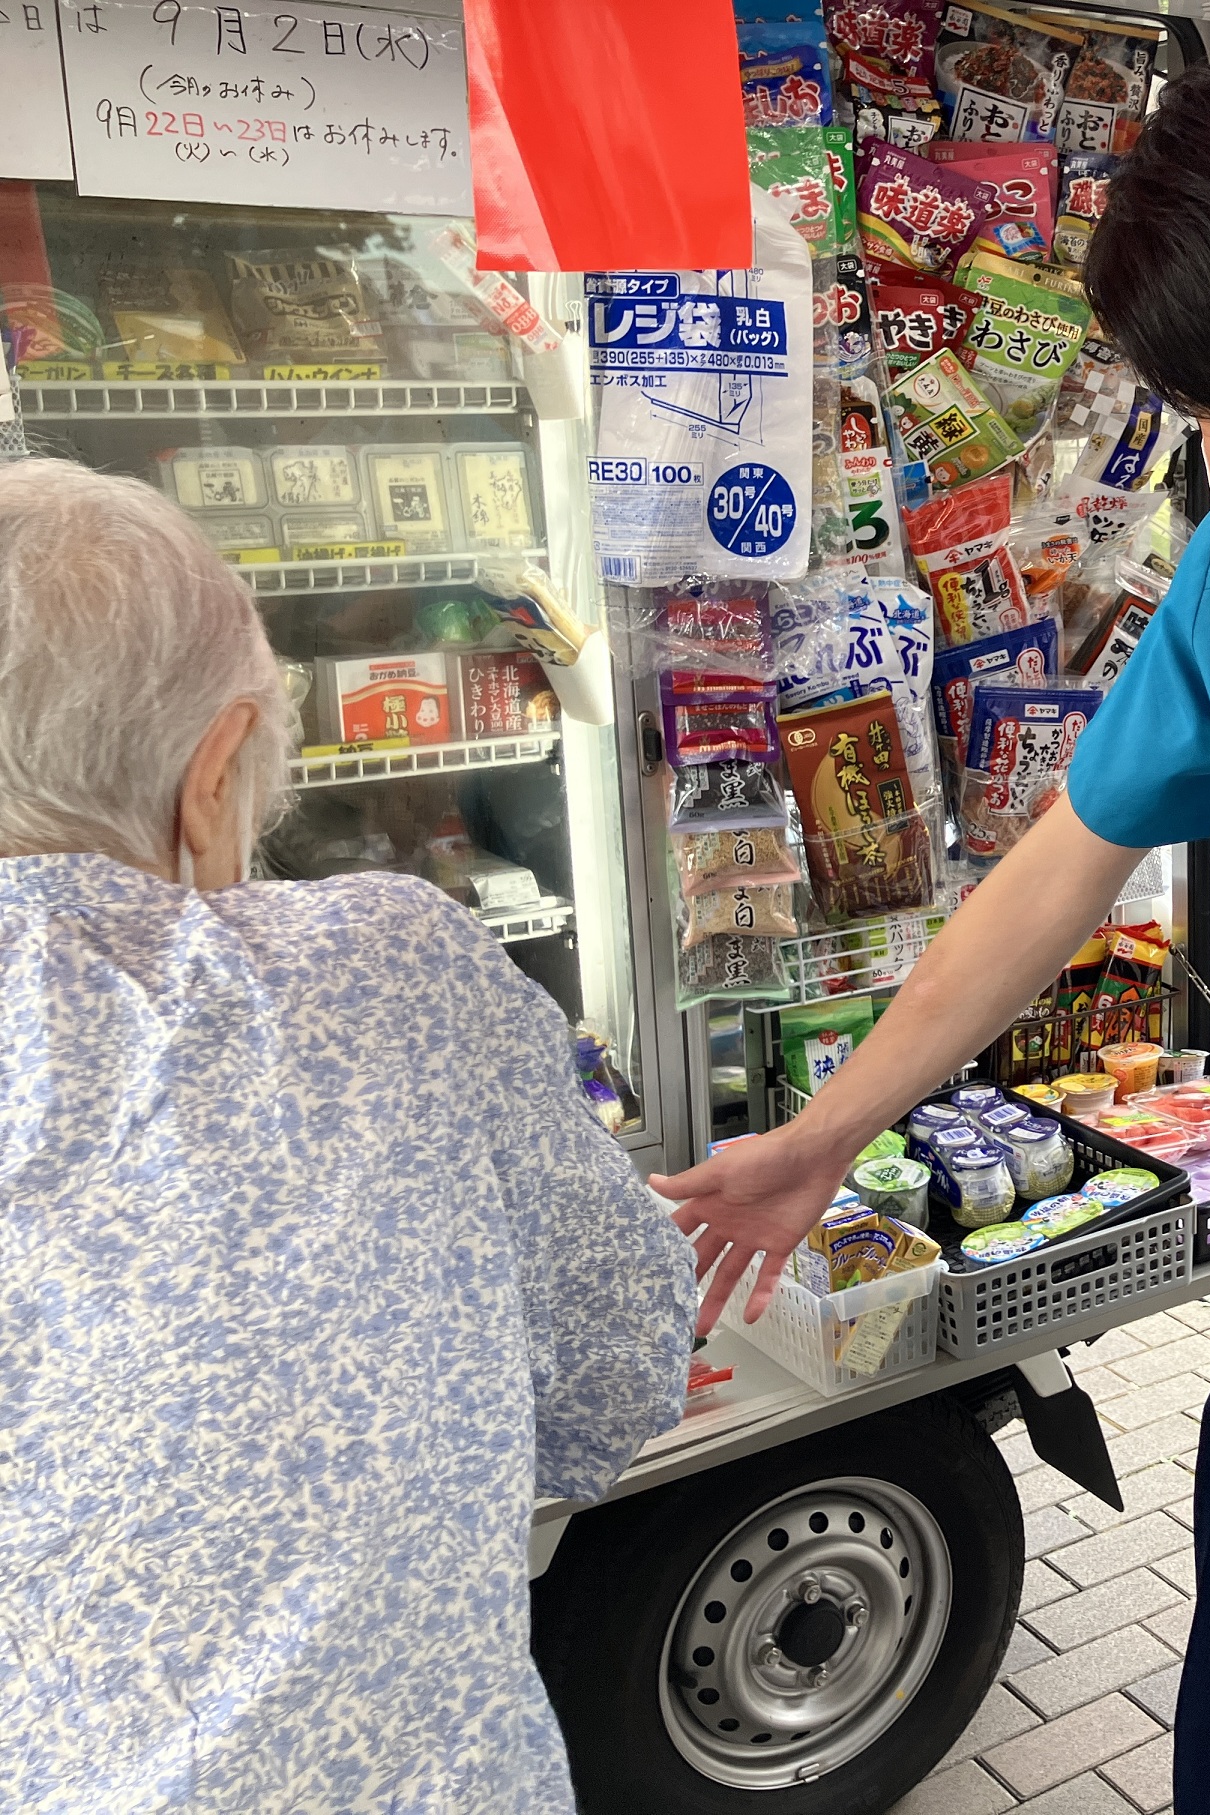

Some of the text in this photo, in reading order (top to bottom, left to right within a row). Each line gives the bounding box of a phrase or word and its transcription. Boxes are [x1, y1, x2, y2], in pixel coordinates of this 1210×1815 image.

[0, 5, 43, 31] 日
[832, 8, 927, 63] 味道楽
[871, 179, 974, 243] 味道楽
[840, 261, 855, 270] 大袋
[593, 301, 722, 348] レジ袋
[735, 306, 772, 328] 乳白
[729, 328, 780, 347] (バッグ)
[970, 318, 1068, 368] わさび
[589, 374, 668, 388] エンボス加工
[728, 382, 743, 391] 135
[688, 424, 707, 432] 255
[588, 460, 643, 482] RE30
[844, 457, 877, 470] ふんわり
[738, 467, 765, 479] 関東
[740, 542, 767, 554] 関西
[964, 541, 993, 556] ヤマキ
[892, 609, 921, 620] 北海道
[986, 654, 1007, 666] ヤマキ
[368, 667, 417, 681] おかめ納豆
[468, 667, 487, 735] ひきわり
[501, 664, 523, 731] 北海道産
